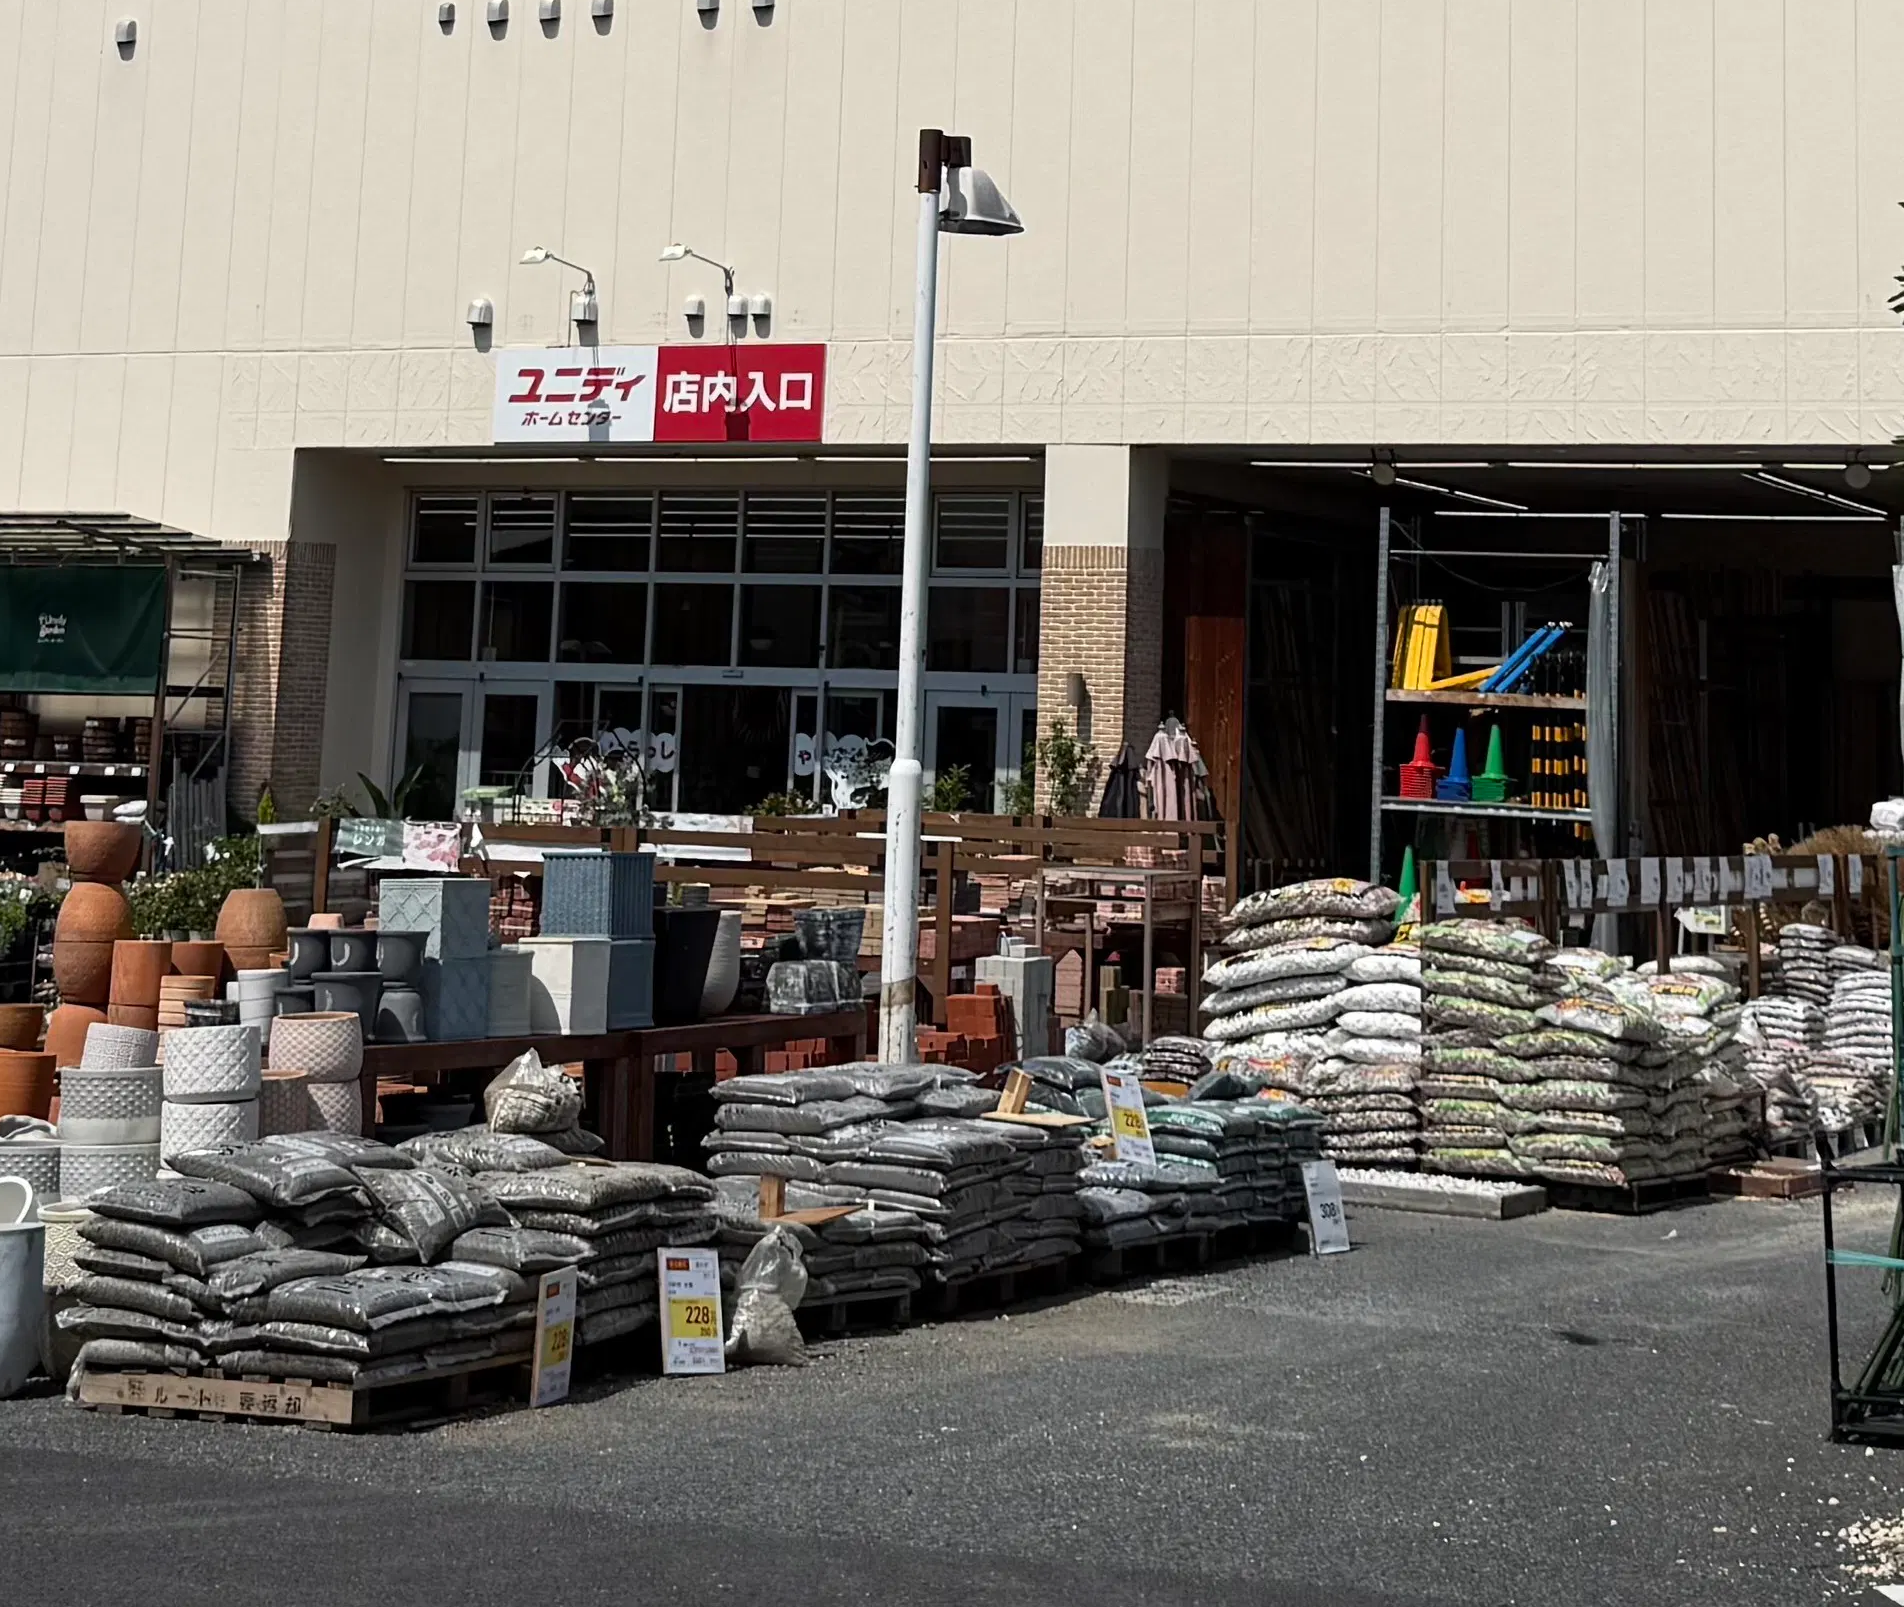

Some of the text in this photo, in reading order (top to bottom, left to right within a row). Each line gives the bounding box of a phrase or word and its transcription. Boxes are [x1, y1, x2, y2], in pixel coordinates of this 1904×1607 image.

[508, 366, 646, 403] ユニディ
[662, 370, 813, 413] 店内入口
